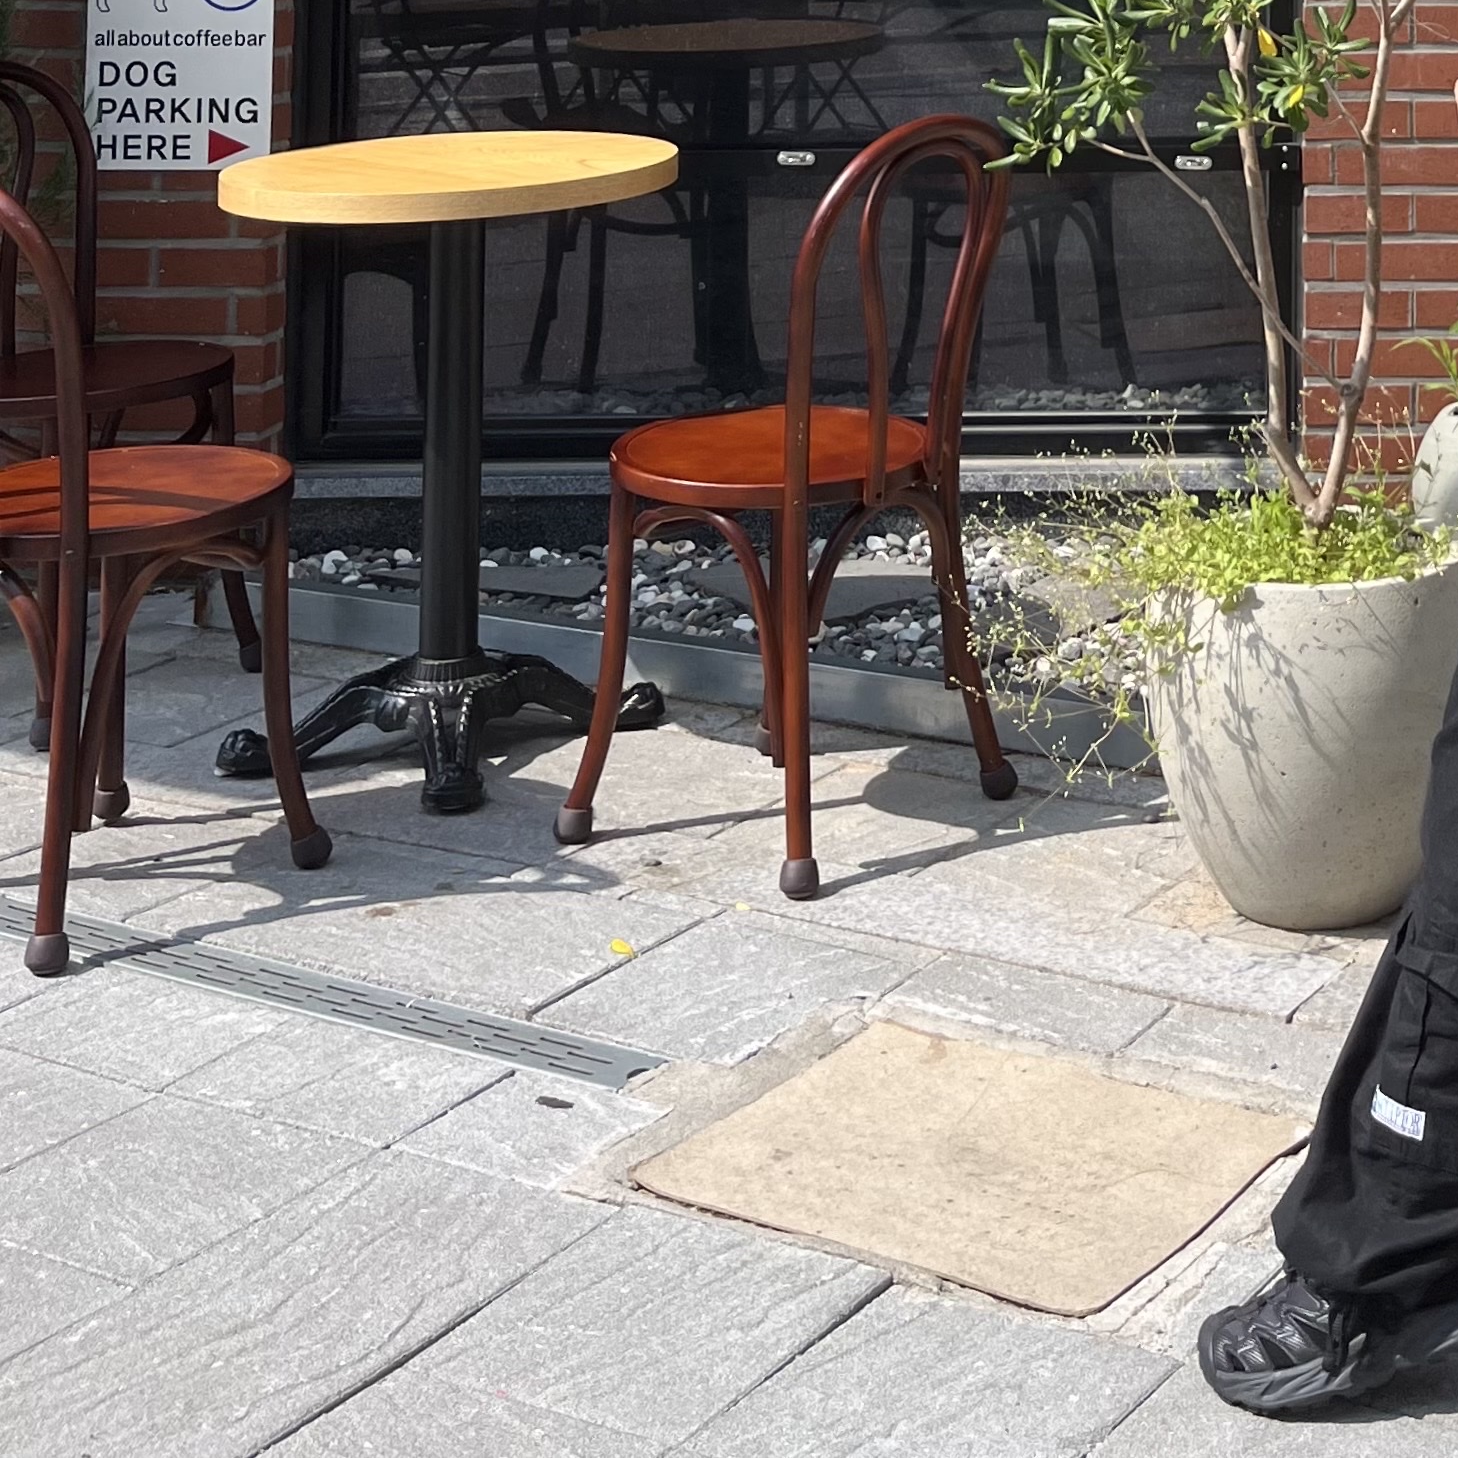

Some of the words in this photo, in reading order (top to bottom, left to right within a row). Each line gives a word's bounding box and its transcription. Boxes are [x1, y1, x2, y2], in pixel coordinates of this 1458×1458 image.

[98, 61, 177, 87] DOG
[97, 97, 259, 124] PARKING
[97, 134, 191, 160] HERE
